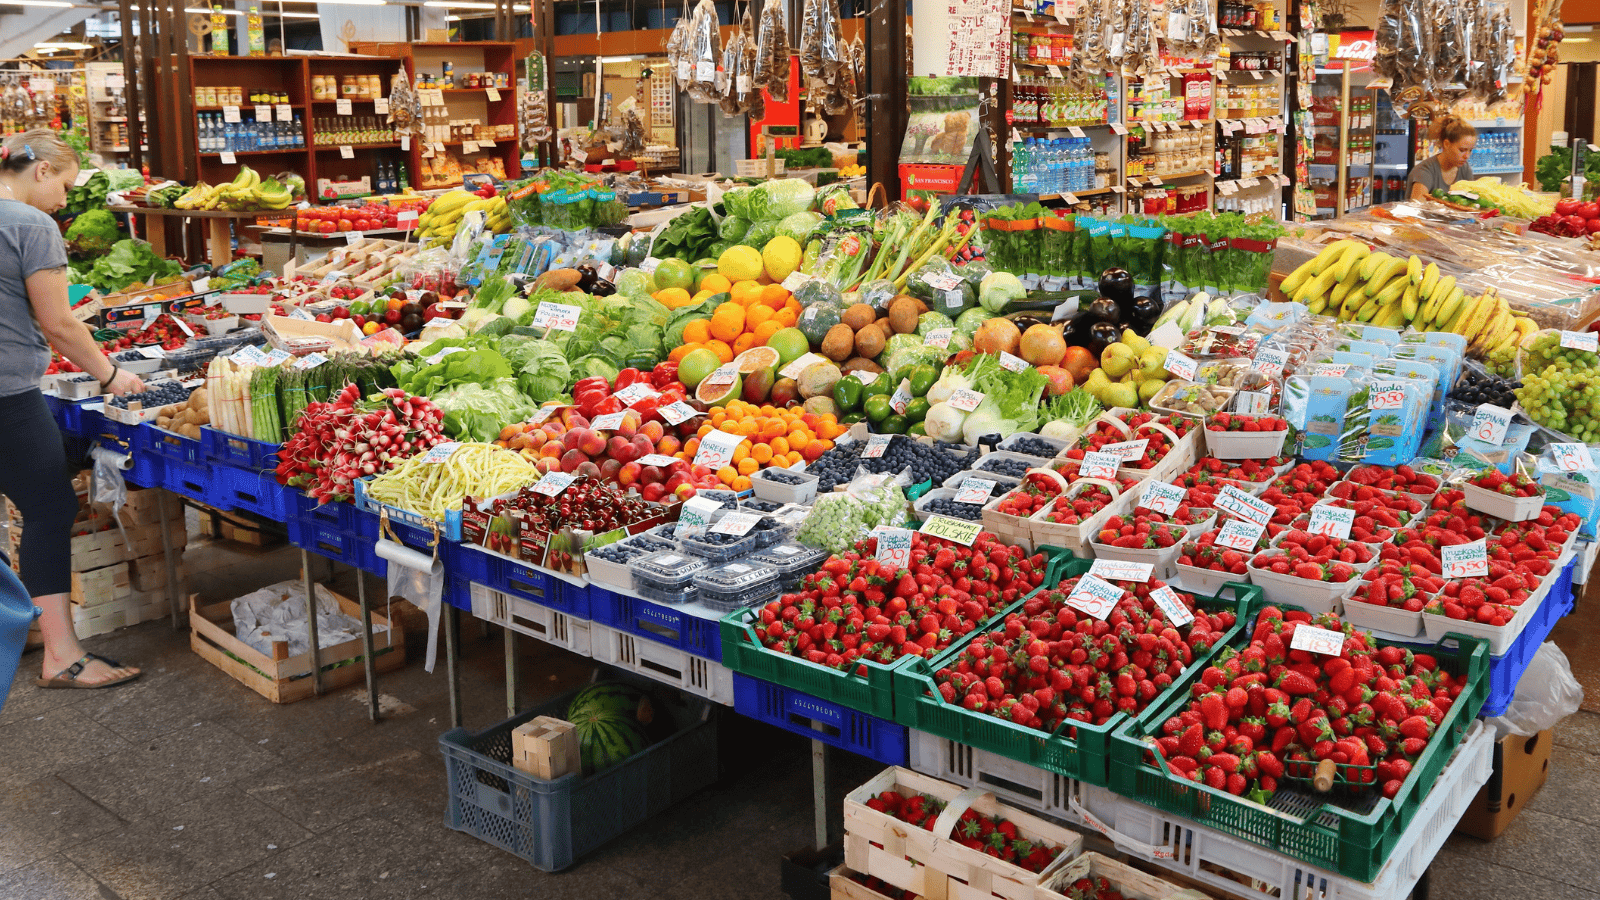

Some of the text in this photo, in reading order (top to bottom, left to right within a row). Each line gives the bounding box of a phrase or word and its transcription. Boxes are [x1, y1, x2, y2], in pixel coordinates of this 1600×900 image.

[1370, 382, 1404, 393] Rucola
[701, 441, 728, 455] MORELE
[928, 522, 977, 543] POLSKIE
